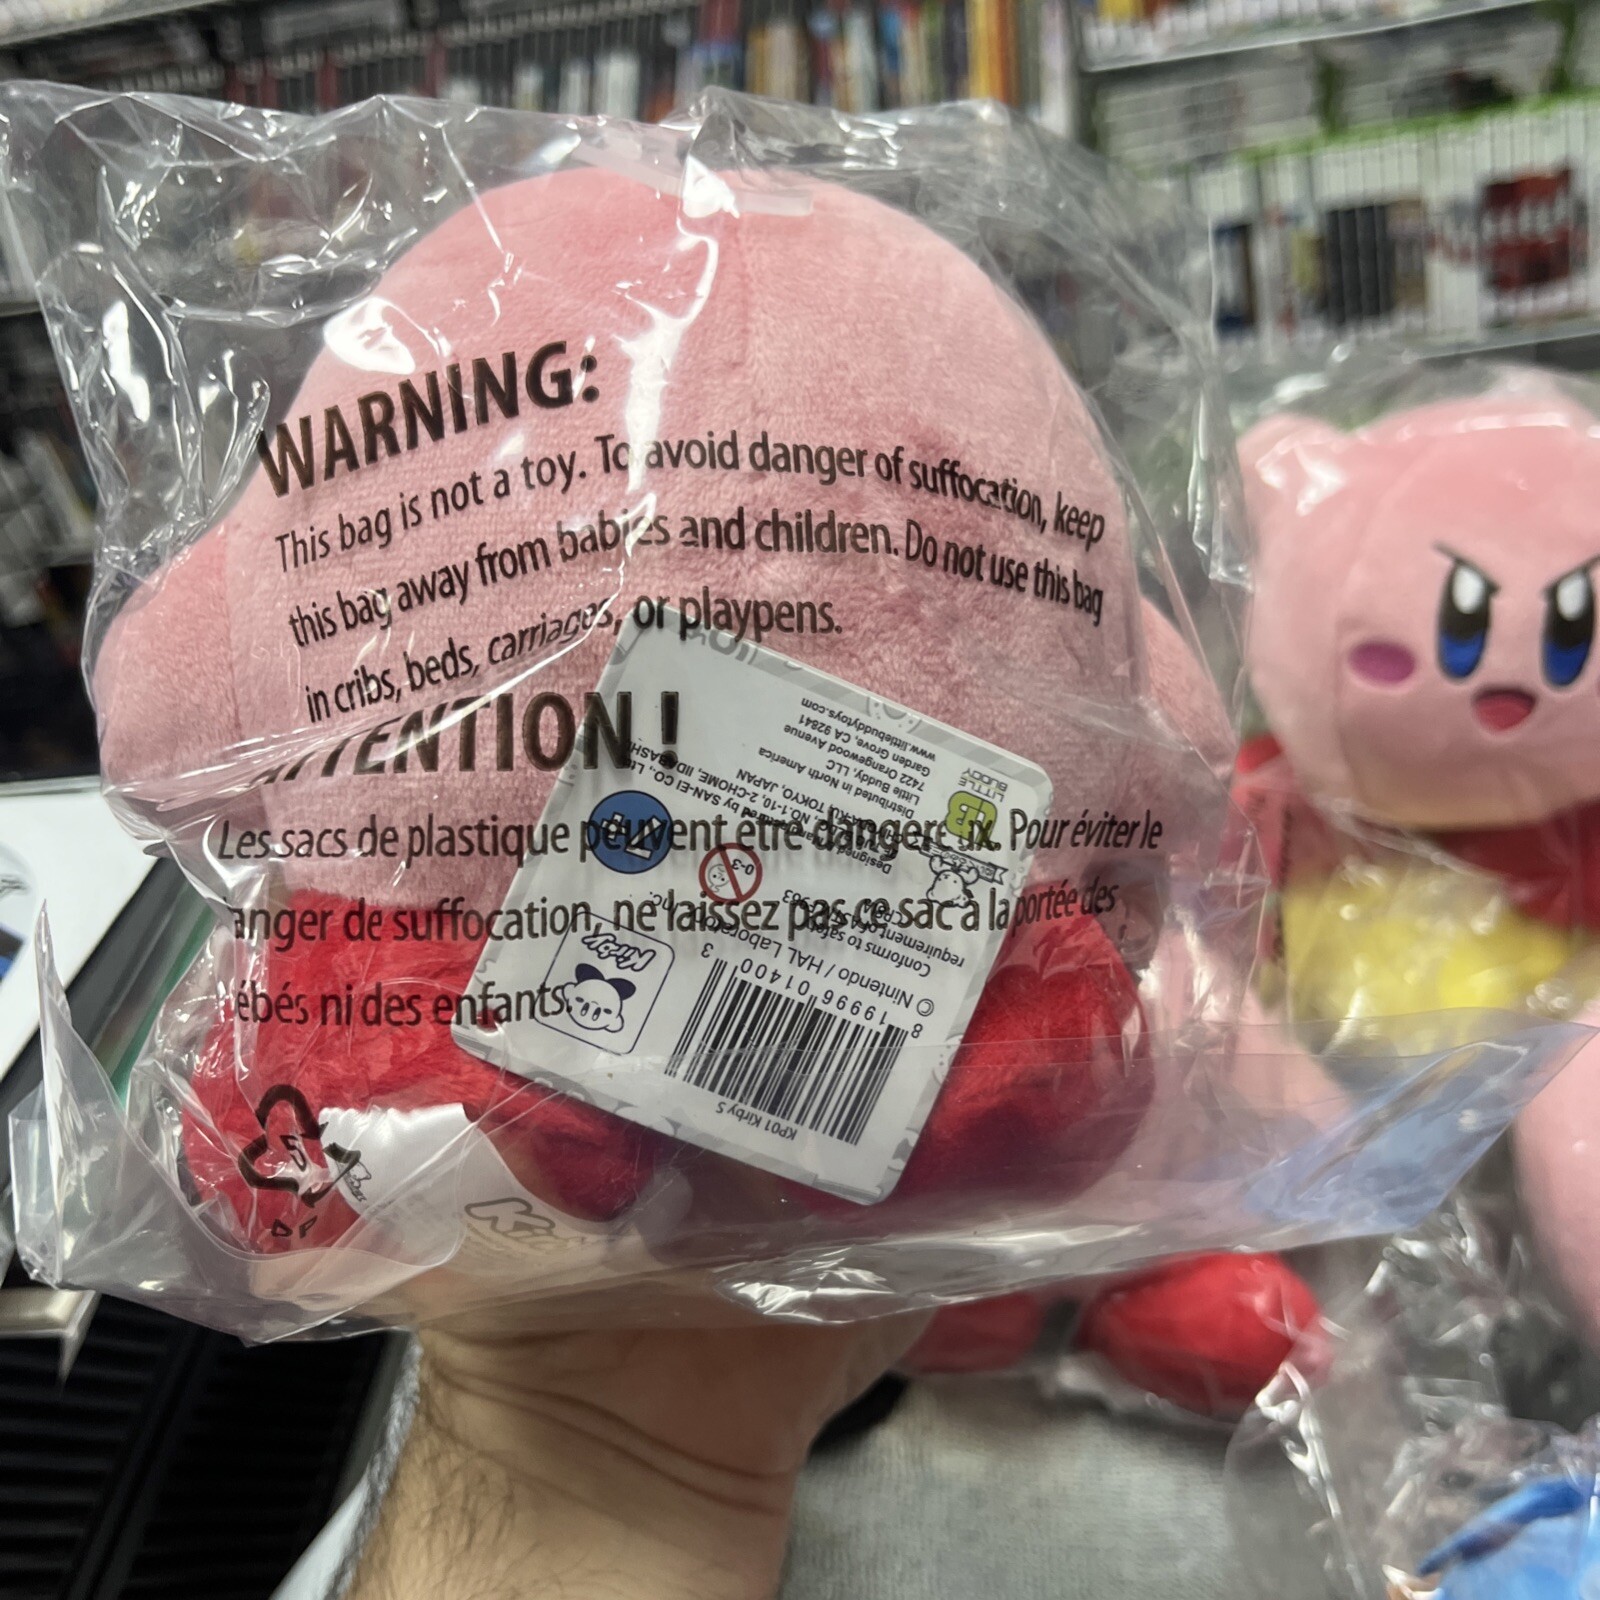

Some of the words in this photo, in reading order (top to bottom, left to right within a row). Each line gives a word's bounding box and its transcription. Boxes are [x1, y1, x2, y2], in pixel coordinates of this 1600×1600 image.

[257, 340, 600, 498] WARNING:
[275, 526, 330, 573] This
[339, 506, 393, 549] bag
[400, 491, 423, 531] is
[432, 471, 485, 519] not
[493, 468, 511, 498] a
[522, 451, 587, 494] toy.
[645, 430, 740, 470] avoid
[748, 433, 868, 486] danger
[874, 444, 905, 483] of
[908, 458, 1049, 534] suffocation,
[1053, 490, 1106, 552] keep
[289, 603, 338, 648] this
[337, 587, 392, 630] bag
[396, 559, 470, 613] away
[475, 533, 551, 587] from
[557, 508, 671, 562] babies
[678, 505, 745, 551] and
[755, 509, 900, 556] children.
[905, 519, 938, 568] Do
[944, 539, 986, 582] not
[990, 555, 1029, 593] use
[1033, 558, 1070, 603] this
[1073, 569, 1105, 627] bag
[306, 685, 330, 723] in
[334, 664, 402, 715] cribs,
[403, 636, 482, 693] beds,
[487, 597, 623, 668] carriages,
[633, 595, 670, 629] or
[679, 585, 843, 643] playpens.
[783, 724, 827, 749] Avenue
[798, 714, 831, 735] 92841
[800, 697, 935, 761] www.littlebuddytoys.com
[834, 728, 851, 743] CA
[758, 746, 806, 773] America
[854, 735, 889, 759] Grove,
[825, 759, 849, 776] LLC
[827, 743, 897, 779] Orangewood
[891, 753, 930, 777] Garden
[649, 765, 674, 786] CO.,
[698, 767, 758, 802] 2-CHOME,
[735, 768, 778, 792] JAPAN
[807, 767, 839, 788] North
[841, 781, 852, 794] in
[853, 768, 890, 793] Buddy,
[899, 773, 924, 791] 7422
[675, 779, 721, 805] SAN-EI
[781, 784, 824, 813] TOKYO,
[892, 786, 919, 805] Little
[957, 776, 1004, 802] LITTLE
[722, 797, 739, 813] by
[762, 794, 810, 824] NO.1-10,
[853, 786, 914, 821] Distributed
[217, 818, 270, 860] Les
[280, 824, 348, 859] sacs
[357, 813, 399, 857] de
[405, 812, 570, 870] plastique
[580, 814, 728, 863] peuvent
[1010, 808, 1070, 851] Pour
[1070, 809, 1140, 849] éviter
[1139, 809, 1163, 850] le
[602, 811, 663, 861] 7+
[728, 858, 756, 875] 0-3
[836, 842, 892, 874] Designed
[226, 904, 334, 953] anger
[343, 896, 383, 942] de
[393, 896, 603, 943] suffocation,
[613, 899, 657, 932] ne
[667, 888, 780, 932] laissez
[787, 897, 846, 941] pas
[852, 897, 891, 932] ce
[898, 897, 953, 931] sac
[988, 887, 1010, 931] la
[1011, 879, 1078, 938] portée
[1080, 876, 1120, 916] des
[644, 891, 679, 915] Inc.
[859, 919, 880, 933] of
[580, 921, 656, 972] Kirby
[700, 942, 713, 958] 3
[847, 935, 862, 950] to
[878, 919, 964, 967] requirement
[787, 946, 823, 974] HAL
[864, 941, 930, 977] Conforms
[740, 958, 810, 995] 01400
[838, 967, 913, 1008] Nintendo
[236, 979, 310, 1024] ébés
[320, 983, 354, 1026] ni
[361, 981, 422, 1027] des
[432, 982, 573, 1030] enfants.
[821, 989, 887, 1025] 19996
[910, 1023, 923, 1038] 8
[726, 1103, 762, 1127] Kirby
[764, 1119, 797, 1140] KP01
